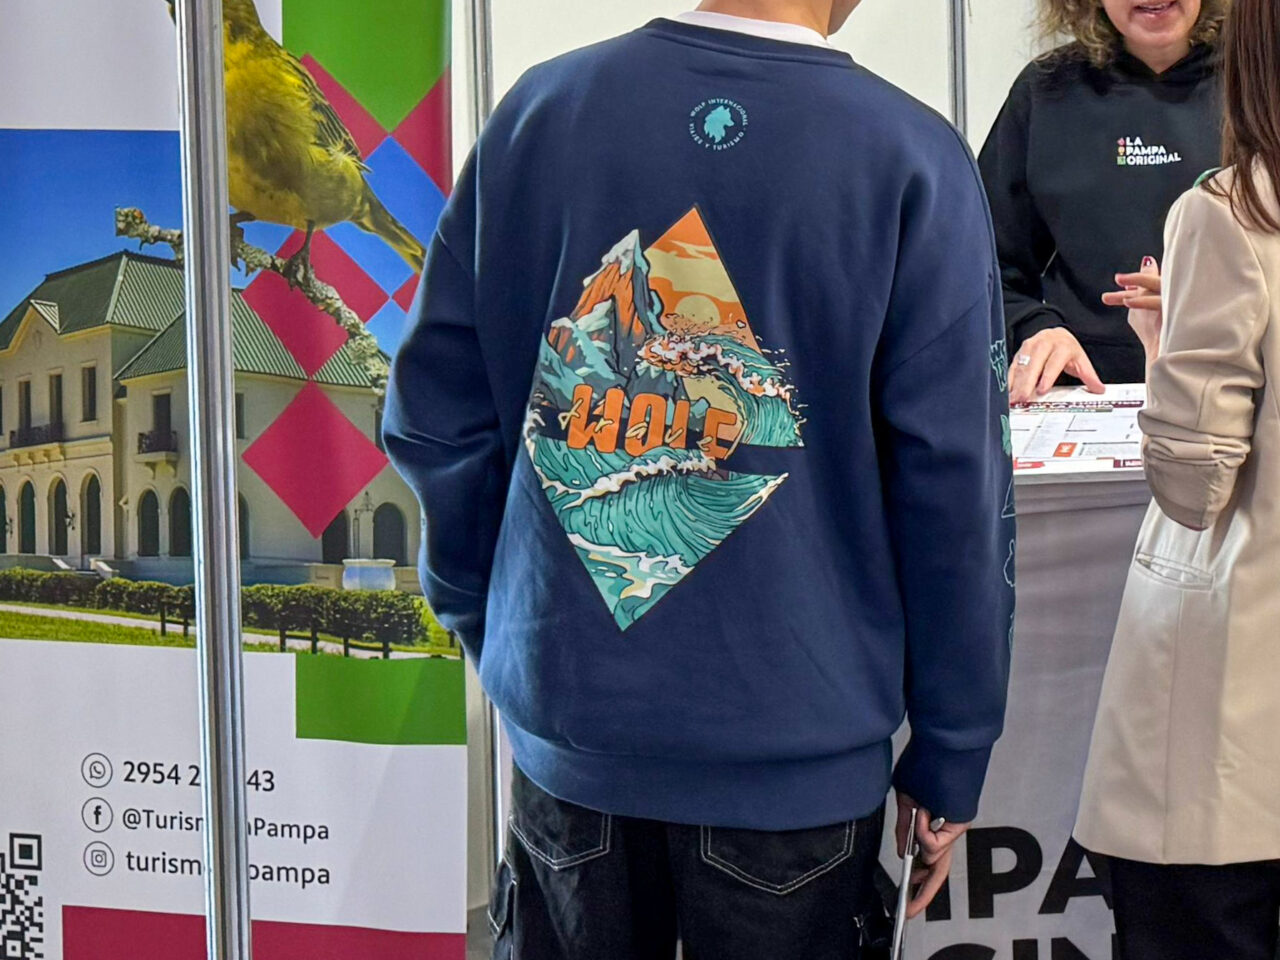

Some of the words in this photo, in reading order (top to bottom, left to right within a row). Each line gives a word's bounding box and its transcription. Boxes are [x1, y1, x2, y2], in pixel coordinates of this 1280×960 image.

[1125, 136, 1143, 146] LA
[1125, 145, 1167, 156] PAMPA
[1126, 152, 1182, 166] ORIGINAL
[123, 760, 182, 786] 2954
